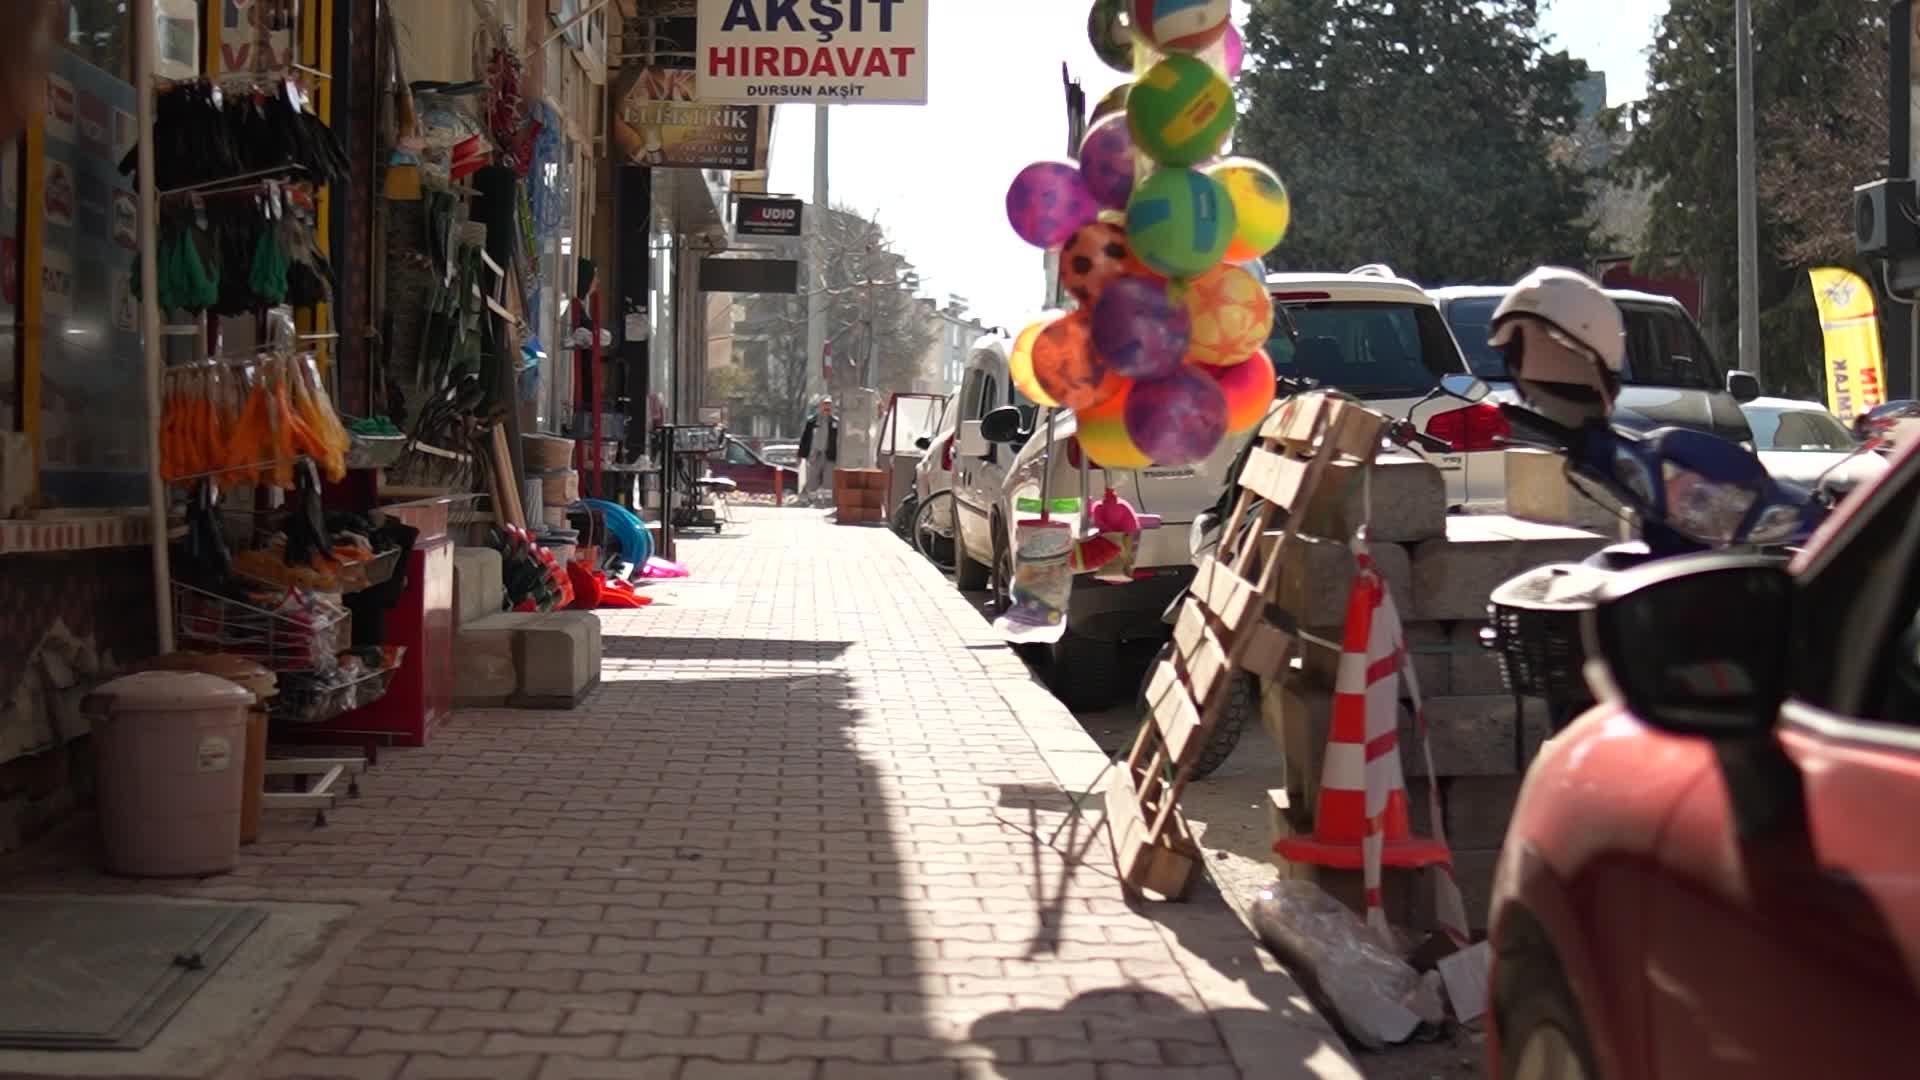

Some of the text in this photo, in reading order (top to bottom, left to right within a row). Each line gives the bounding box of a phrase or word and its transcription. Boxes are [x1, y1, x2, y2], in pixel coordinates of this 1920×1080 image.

[708, 46, 915, 77] HIRDAVAT
[747, 84, 865, 99] DURSUN AKŞİT
[752, 207, 796, 220] UDIO
